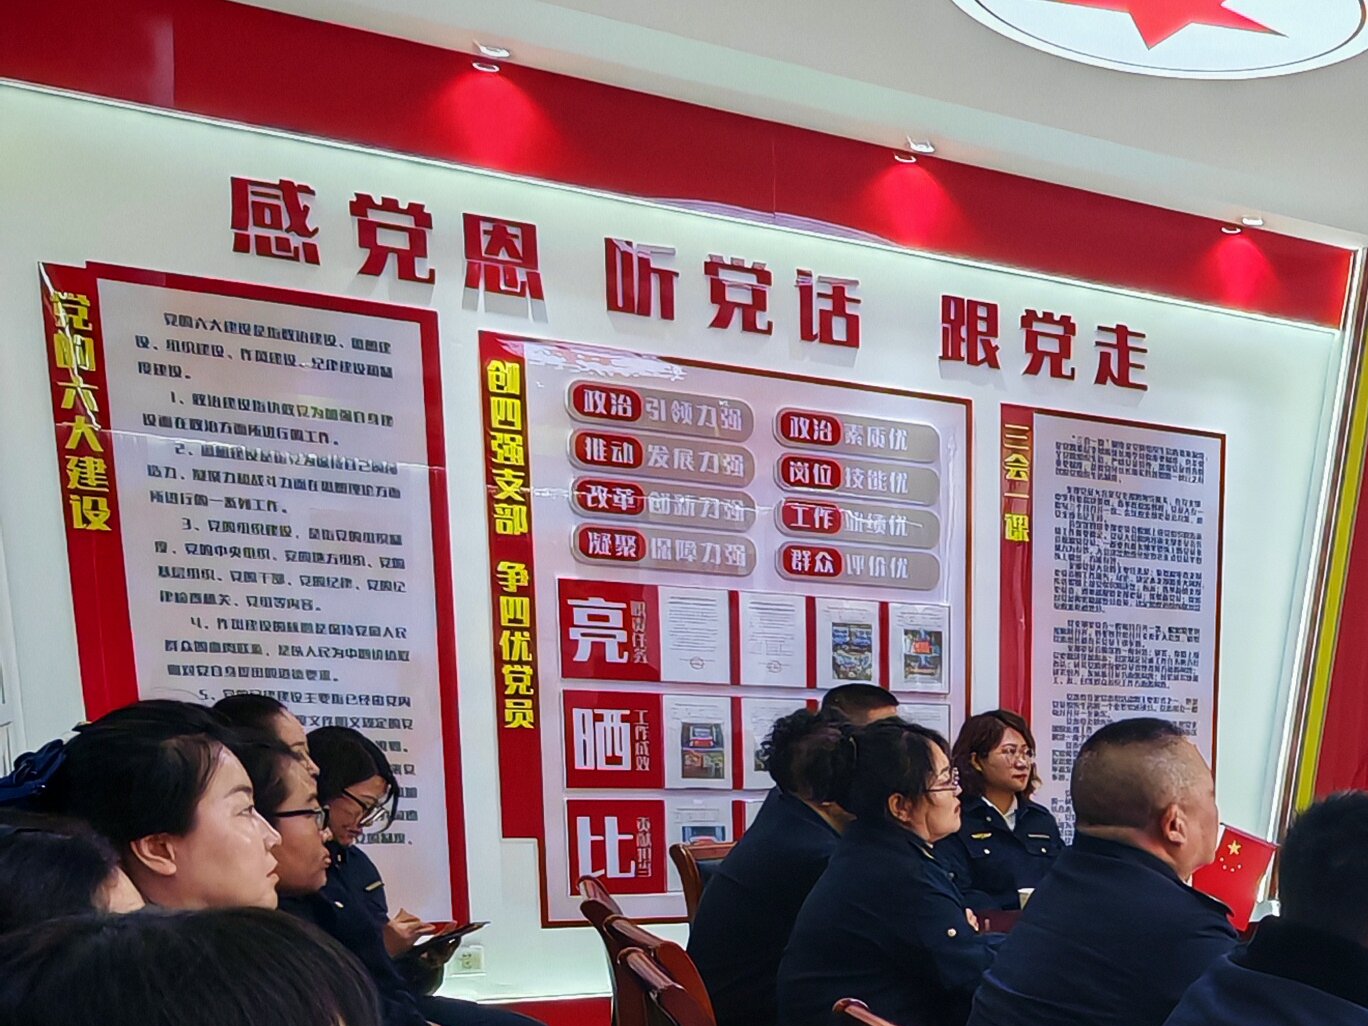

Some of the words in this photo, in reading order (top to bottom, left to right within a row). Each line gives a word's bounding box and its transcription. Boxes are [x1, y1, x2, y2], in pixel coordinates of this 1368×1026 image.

[230, 176, 544, 300] 感党恩
[603, 237, 863, 348] 听党话
[939, 296, 1149, 392] 跟党走
[53, 291, 112, 531] 党的六大建设
[487, 359, 528, 536] 创四强支部
[1003, 424, 1030, 542] 三会一课
[496, 561, 534, 729] 争四优党员
[567, 597, 628, 664] 亮
[572, 708, 632, 771] 晒
[577, 816, 635, 878] 比
